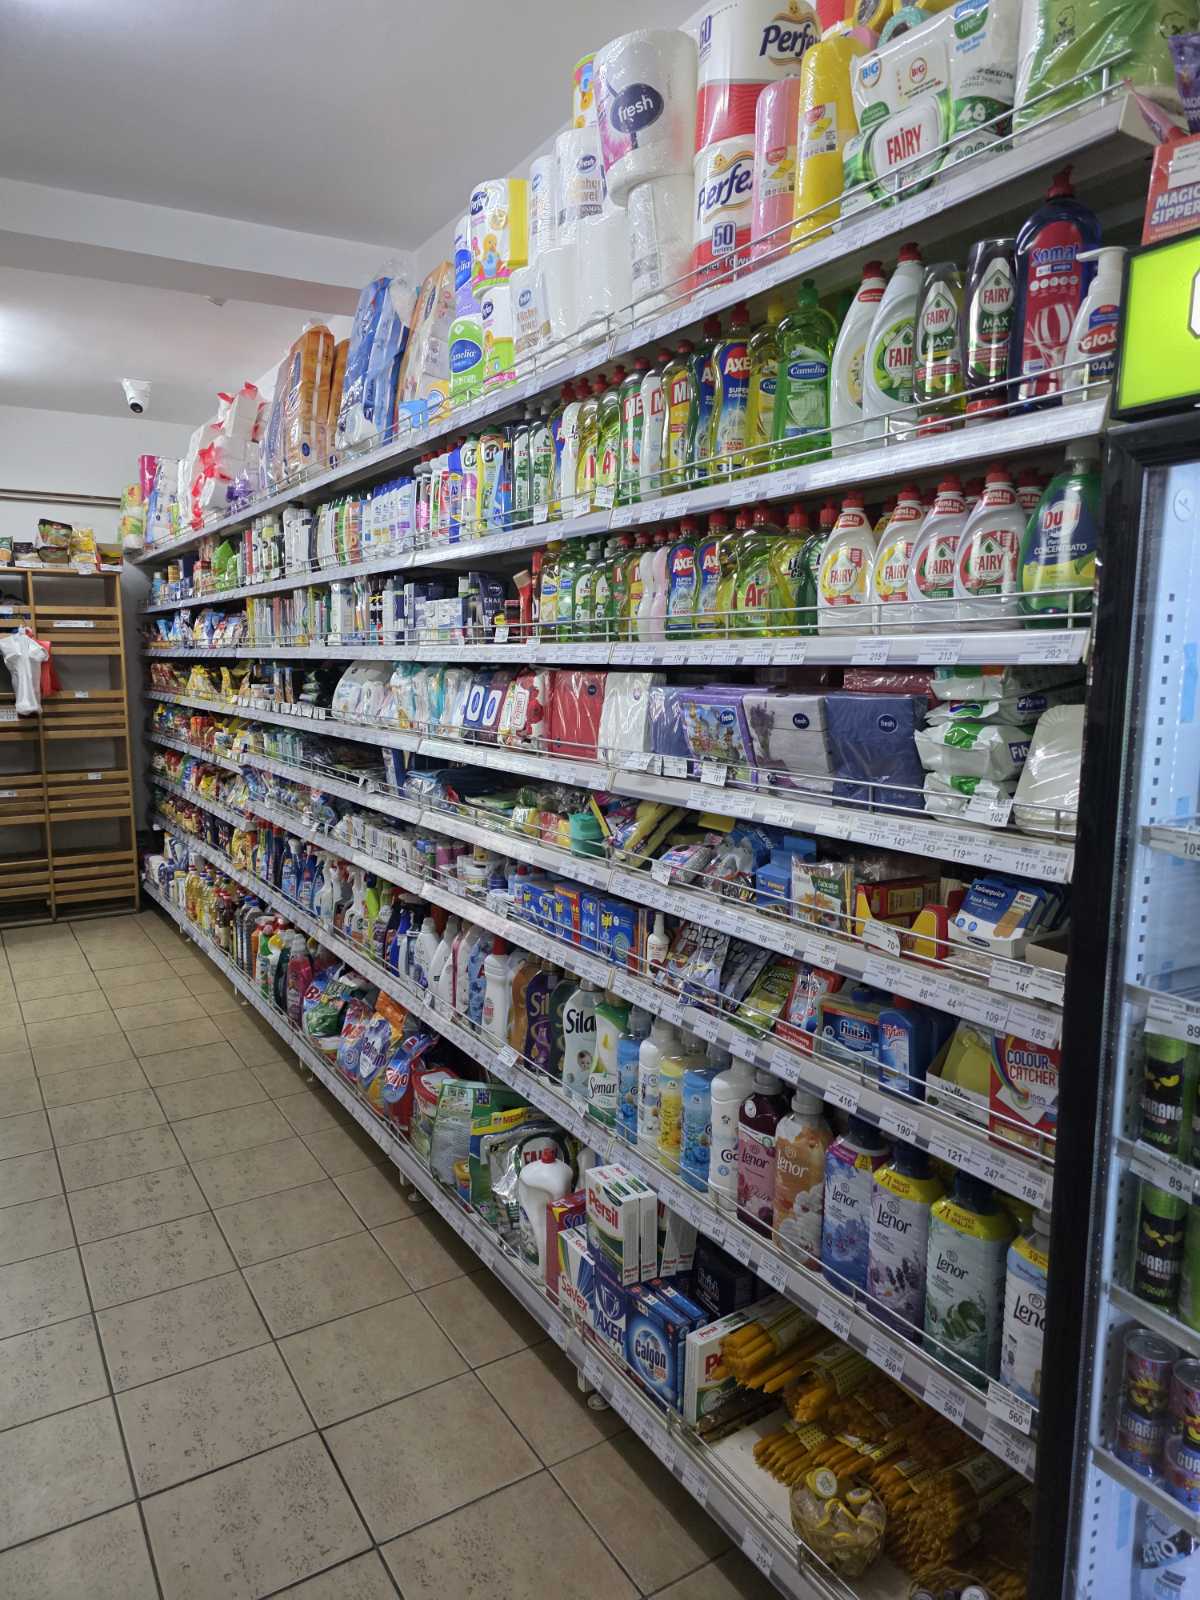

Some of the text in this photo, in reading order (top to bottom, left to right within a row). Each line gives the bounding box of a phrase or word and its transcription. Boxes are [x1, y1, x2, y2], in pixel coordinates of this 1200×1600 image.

[760, 24, 820, 56] Perfe
[862, 62, 878, 79] BIG
[911, 64, 925, 77] BIG
[618, 95, 654, 122] fresh
[698, 163, 752, 220] Perfe
[1156, 186, 1200, 208] MAGIC
[714, 224, 732, 246] 50
[1032, 243, 1079, 266] Somat
[984, 288, 1010, 304] FAIRY
[926, 309, 950, 325] FAIRY
[983, 316, 1008, 328] MAX
[724, 356, 752, 374] AXE
[790, 364, 826, 375] Camelia
[928, 560, 955, 576] FAIRY
[974, 554, 1004, 571] FAIRY
[830, 569, 852, 584] FAIRY
[885, 564, 908, 580] FAIRY
[881, 720, 894, 728] fresh
[952, 848, 966, 858] 119
[1042, 866, 1057, 876] 104
[530, 992, 550, 1018] Sil
[566, 1008, 596, 1034] Sila
[840, 1019, 871, 1042] finish
[1031, 1027, 1046, 1040] 185
[1007, 1049, 1049, 1070] COLOUR
[1009, 1065, 1056, 1086] CATCHER
[897, 1124, 911, 1136] 190
[948, 1149, 962, 1162] 121
[984, 1166, 998, 1179] 247
[1169, 1176, 1182, 1191] 89
[832, 1185, 858, 1208] Lenor
[1022, 1186, 1036, 1199] 188
[588, 1190, 618, 1230] Persil
[877, 1204, 912, 1234] Lenor
[937, 1253, 968, 1280] Lenor
[562, 1276, 588, 1312] Savex
[597, 1312, 624, 1346] AXEL
[635, 1340, 666, 1370] calgon
[944, 1402, 958, 1417] 560
[1008, 1409, 1024, 1426] 560
[1142, 1540, 1177, 1564] ZERO
